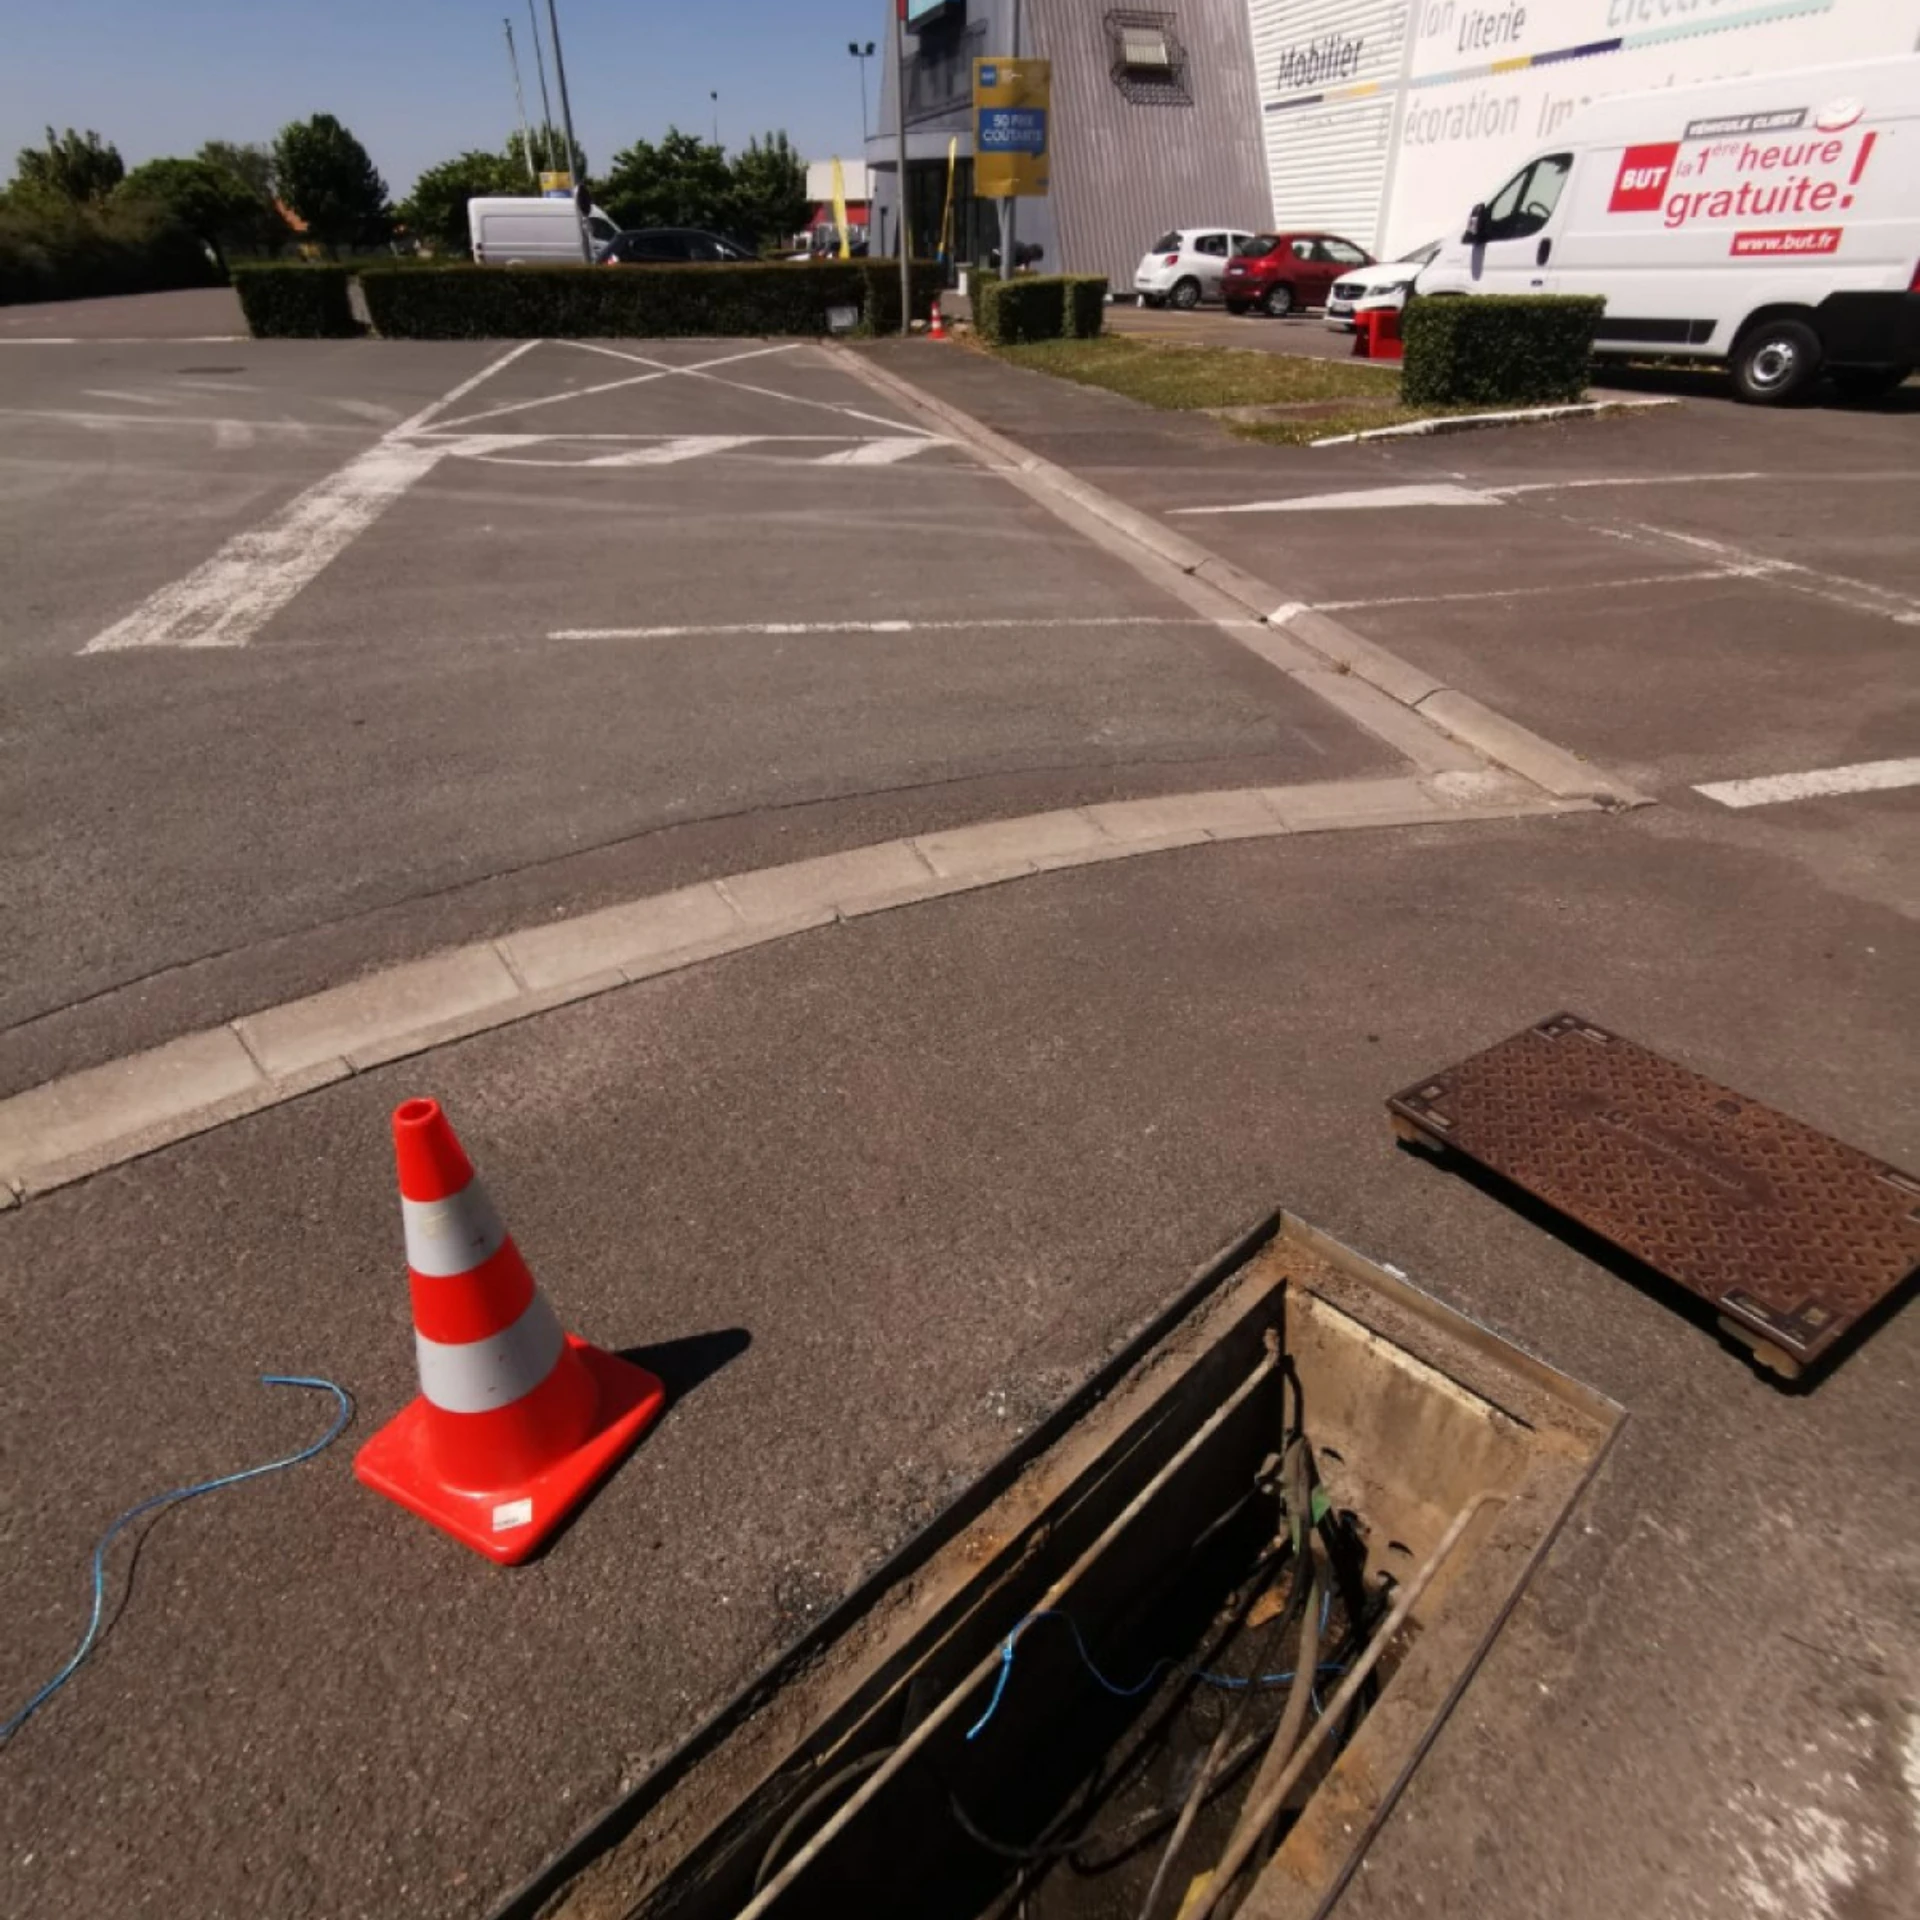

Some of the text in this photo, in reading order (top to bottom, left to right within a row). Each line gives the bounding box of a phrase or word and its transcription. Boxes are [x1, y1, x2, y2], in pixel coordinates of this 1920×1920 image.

[1457, 0, 1525, 53] Literie
[1277, 33, 1364, 90] Mobilier
[1675, 161, 1693, 178] la
[1738, 140, 1843, 172] heure
[1619, 167, 1666, 190] BUT
[1736, 230, 1835, 252] www.but.fr
